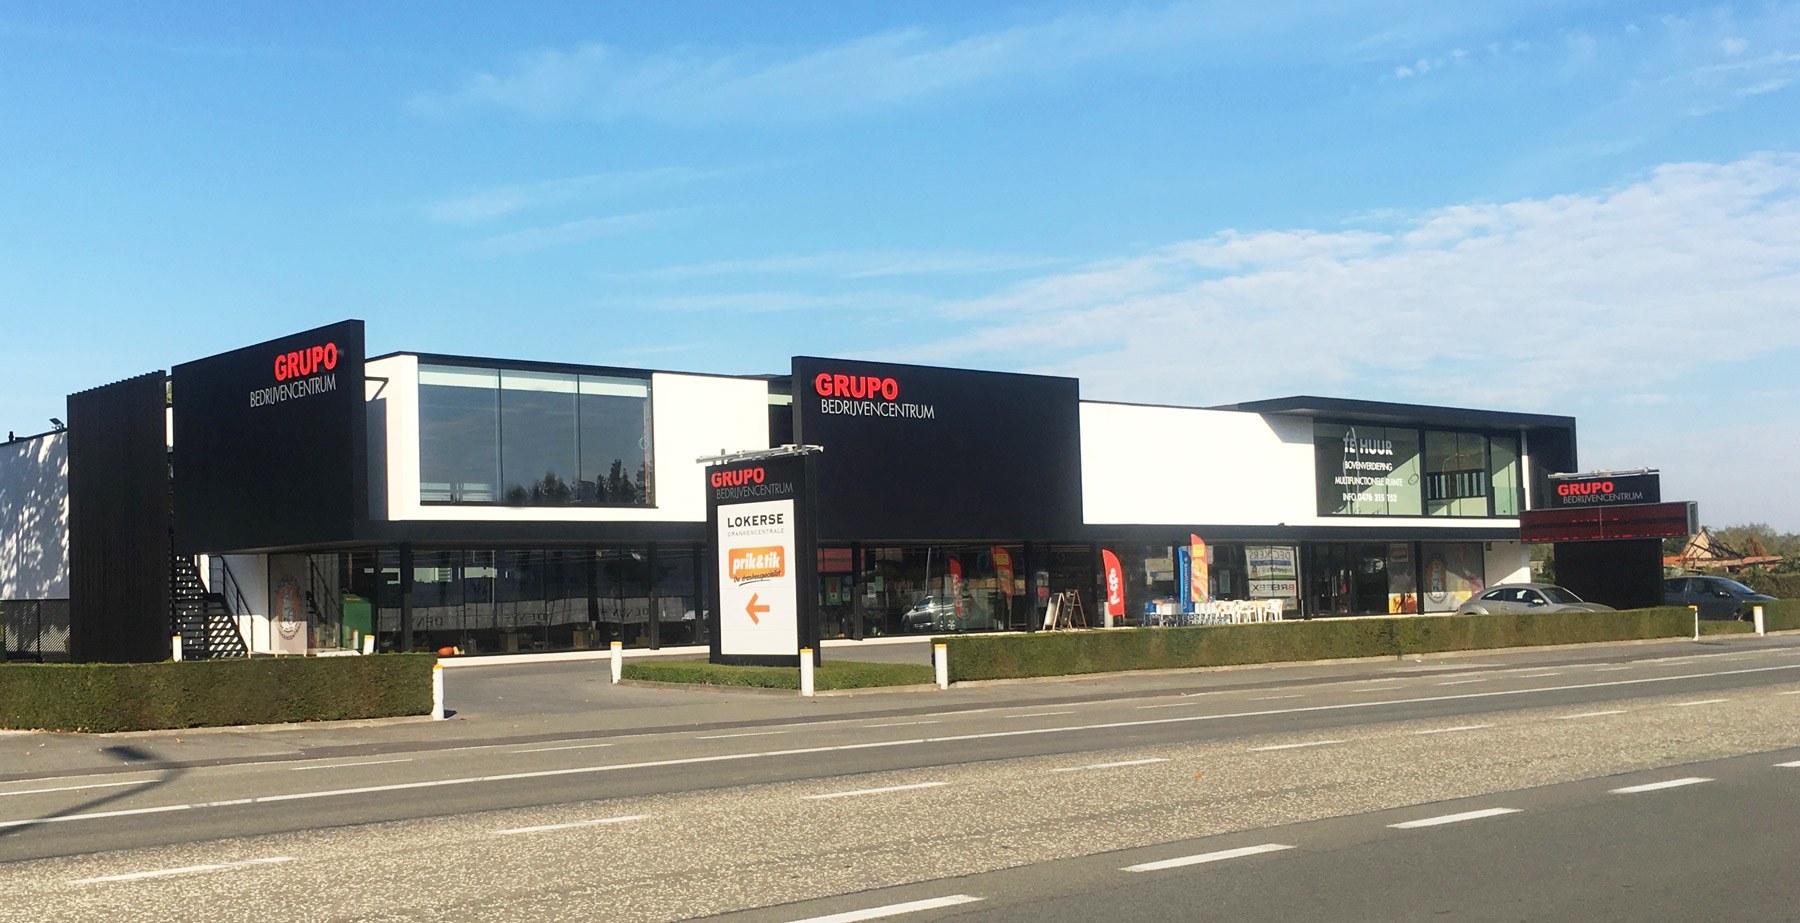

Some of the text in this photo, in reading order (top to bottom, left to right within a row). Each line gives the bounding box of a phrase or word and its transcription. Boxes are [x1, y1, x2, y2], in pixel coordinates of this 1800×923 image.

[274, 342, 337, 381] GRUPO
[250, 373, 337, 408] BEDRIJVENCENTRUM
[815, 373, 898, 400] GRUPO
[821, 399, 935, 419] BEDRIJVENCENTRUM
[1343, 437, 1394, 455] TE HUUR
[1344, 460, 1393, 472] BOVENVERDIEPING
[711, 467, 765, 488] GRUPO
[716, 482, 794, 499] BEDRIJVENCENTRUM
[1557, 481, 1614, 496] GRUPO
[1343, 492, 1356, 502] INFO
[1358, 492, 1373, 502] 0476
[1387, 493, 1398, 503] 152
[1563, 492, 1643, 504] BEDRIJVENCENTRUM
[727, 513, 784, 528] LOKERSE
[727, 528, 785, 538] DRANKENCENTRALE
[732, 551, 781, 575] prik&tik
